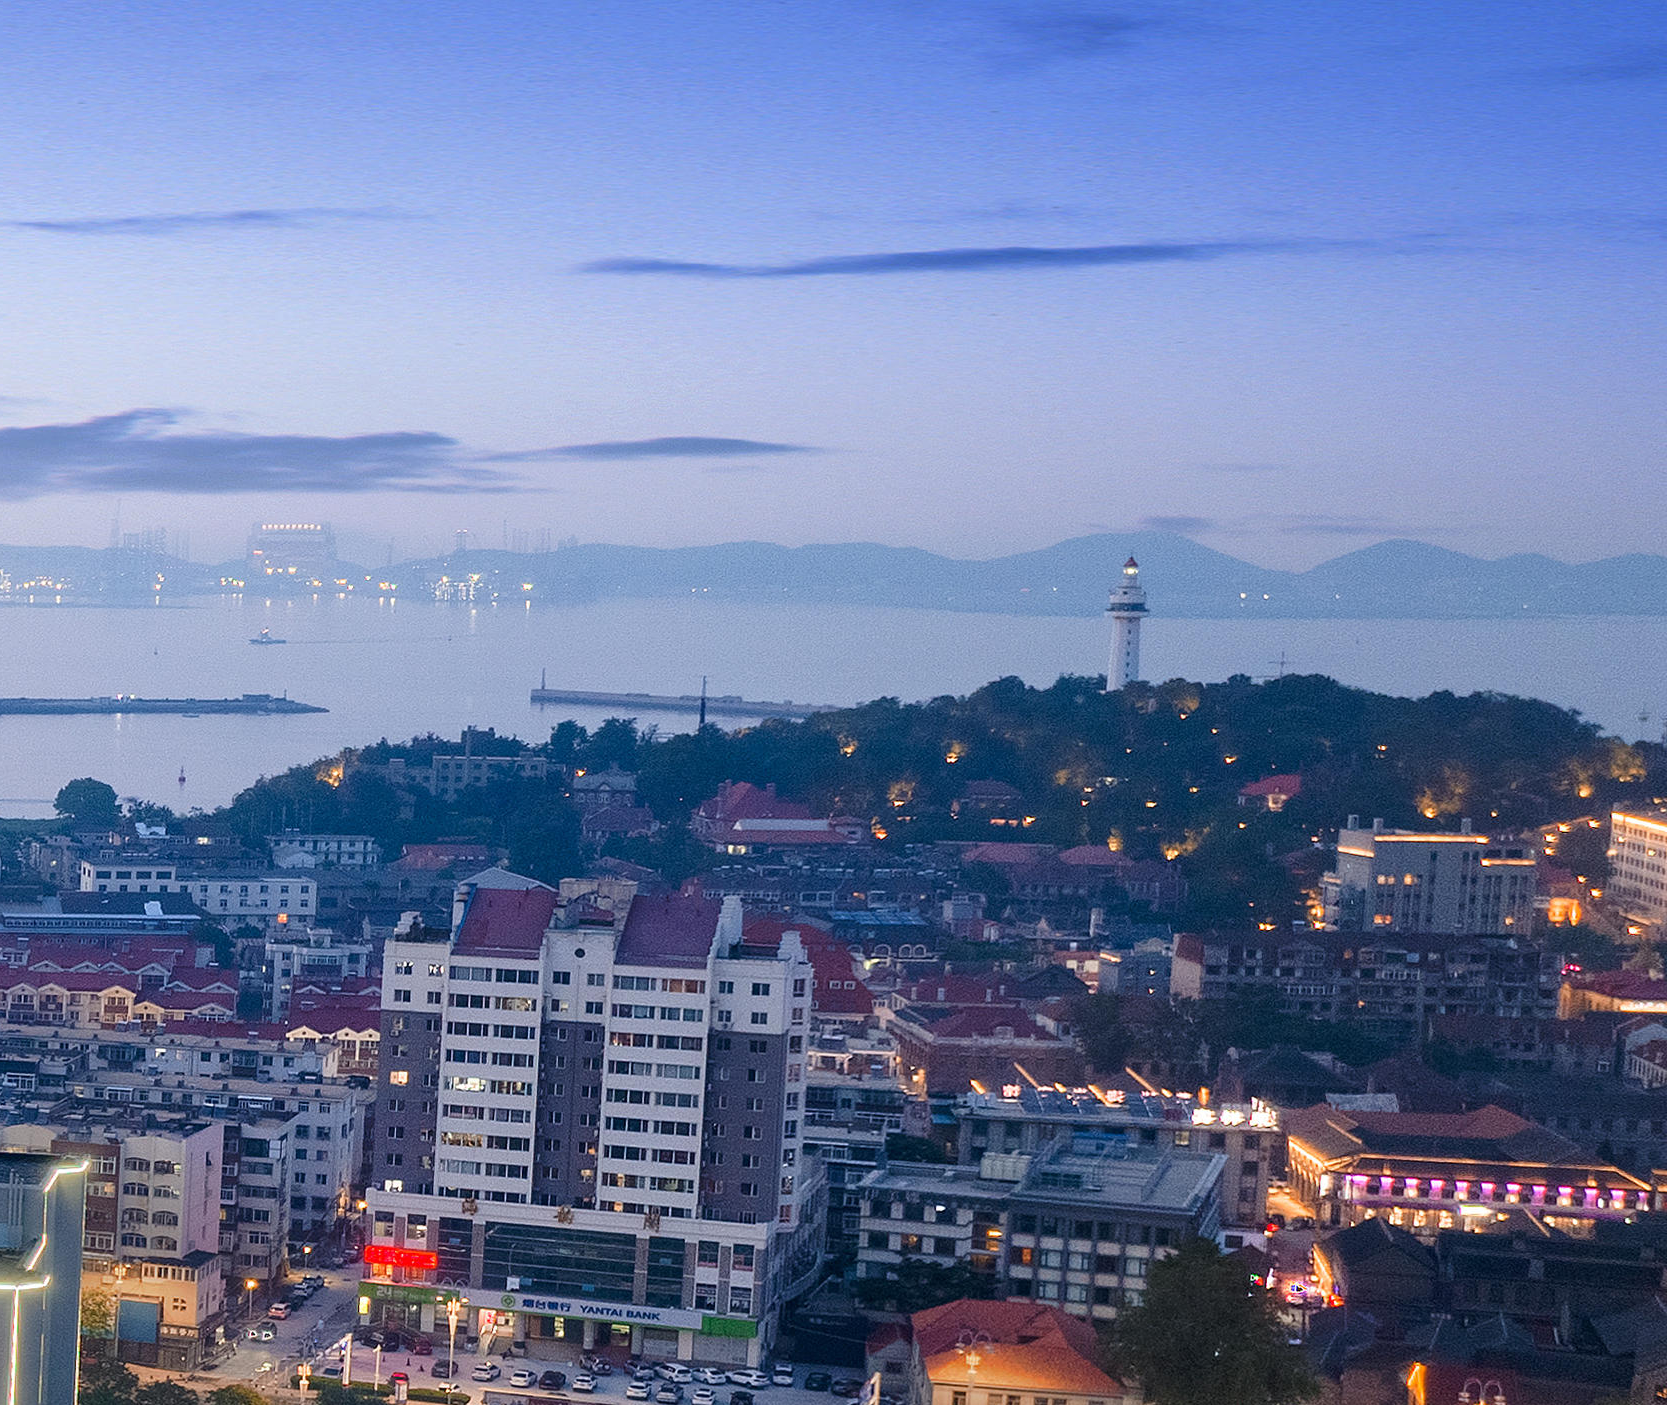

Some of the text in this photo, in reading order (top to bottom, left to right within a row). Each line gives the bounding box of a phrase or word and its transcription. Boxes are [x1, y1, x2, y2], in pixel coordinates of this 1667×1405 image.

[521, 1298, 661, 1322] 烟台银行 YANTAI BANK
